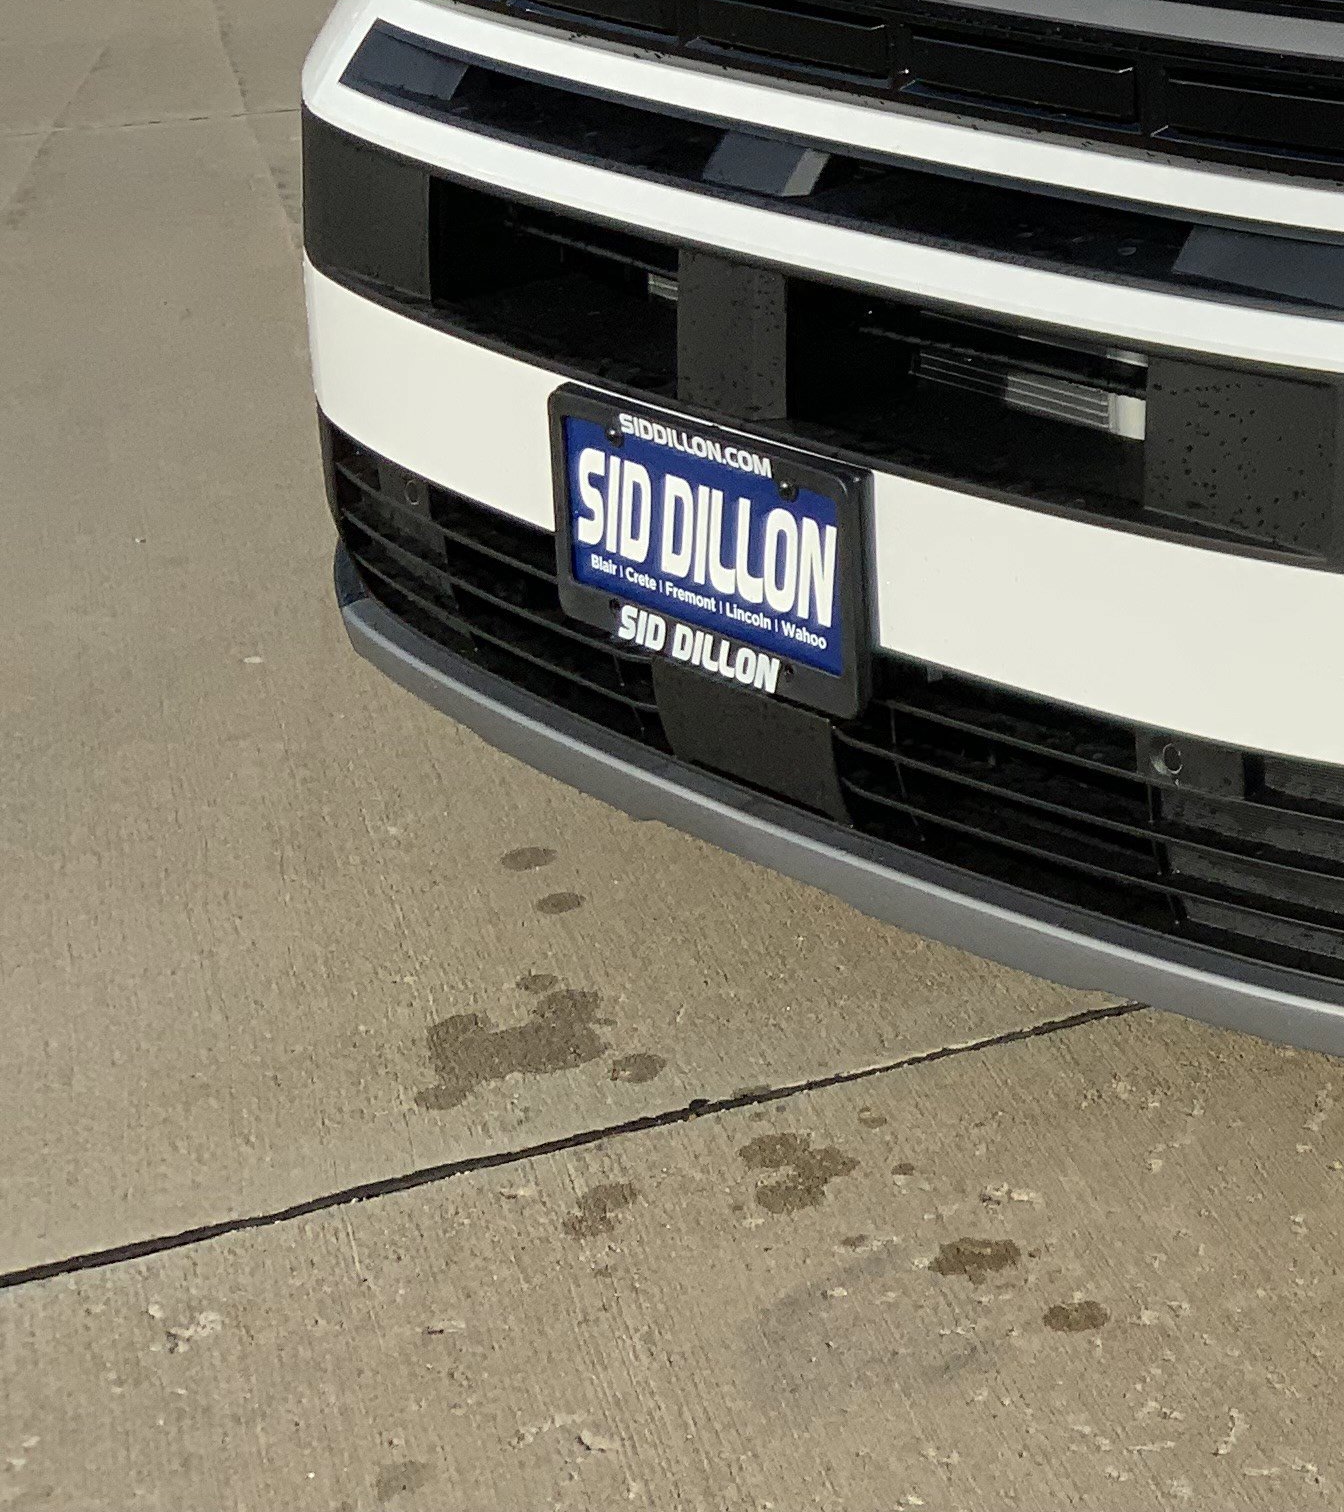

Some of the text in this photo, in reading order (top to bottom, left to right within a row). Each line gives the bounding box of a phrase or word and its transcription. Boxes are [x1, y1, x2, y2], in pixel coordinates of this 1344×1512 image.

[618, 413, 773, 479] SIDDILLON.COM
[577, 447, 838, 628] SID DILLON
[591, 553, 827, 650] Blair Crete Fremont Lincoln Wahoo
[618, 605, 781, 694] SID DILLON
